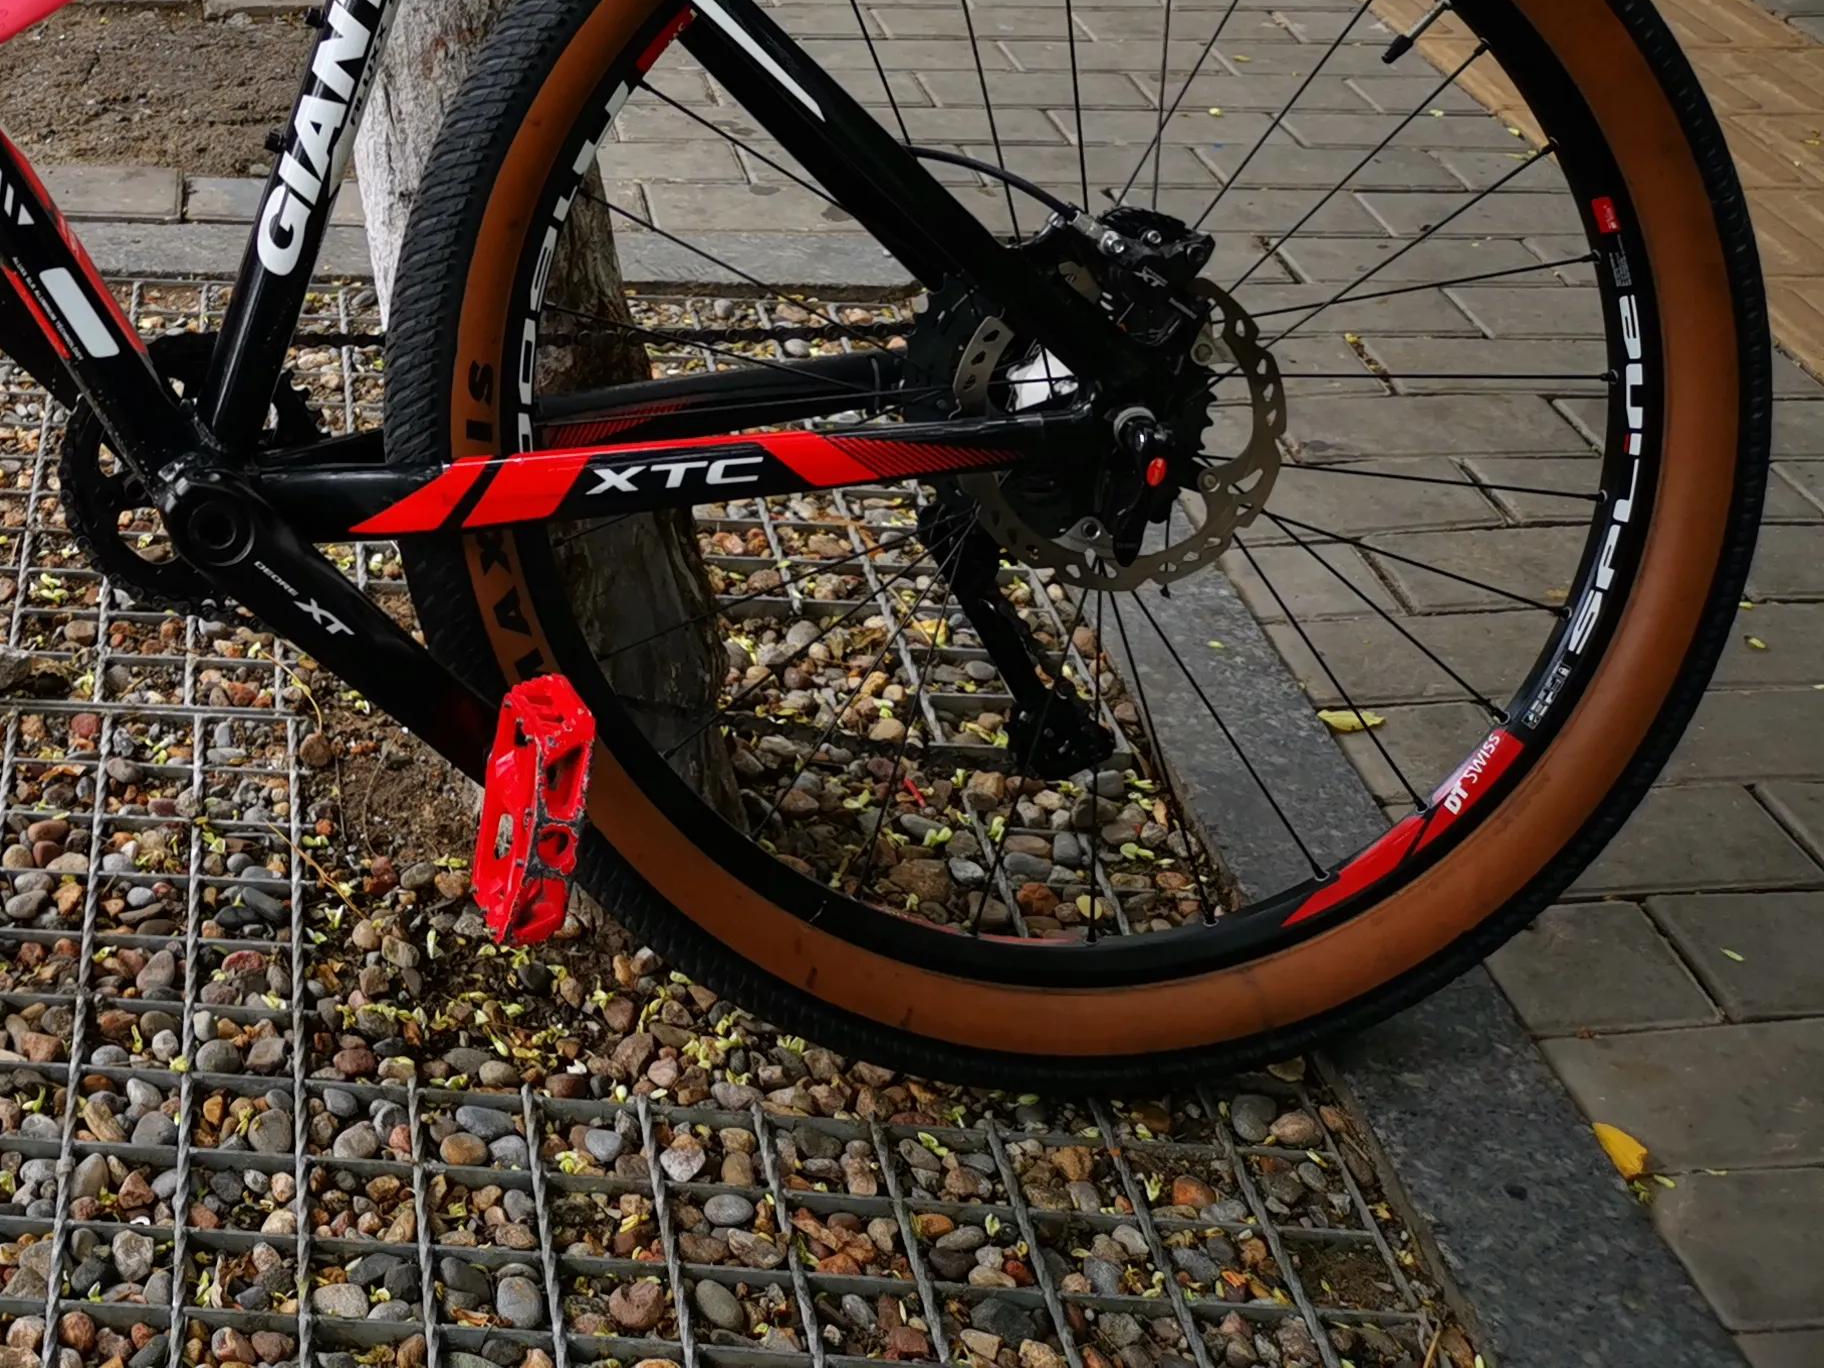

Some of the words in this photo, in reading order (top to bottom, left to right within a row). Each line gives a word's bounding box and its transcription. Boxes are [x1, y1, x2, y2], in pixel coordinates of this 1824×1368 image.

[585, 455, 766, 497] XTC
[1566, 293, 1644, 657] SPLINE
[252, 558, 299, 599] DEORE
[293, 589, 355, 646] XT
[1443, 781, 1472, 818] DT
[1464, 729, 1504, 786] SWISS
